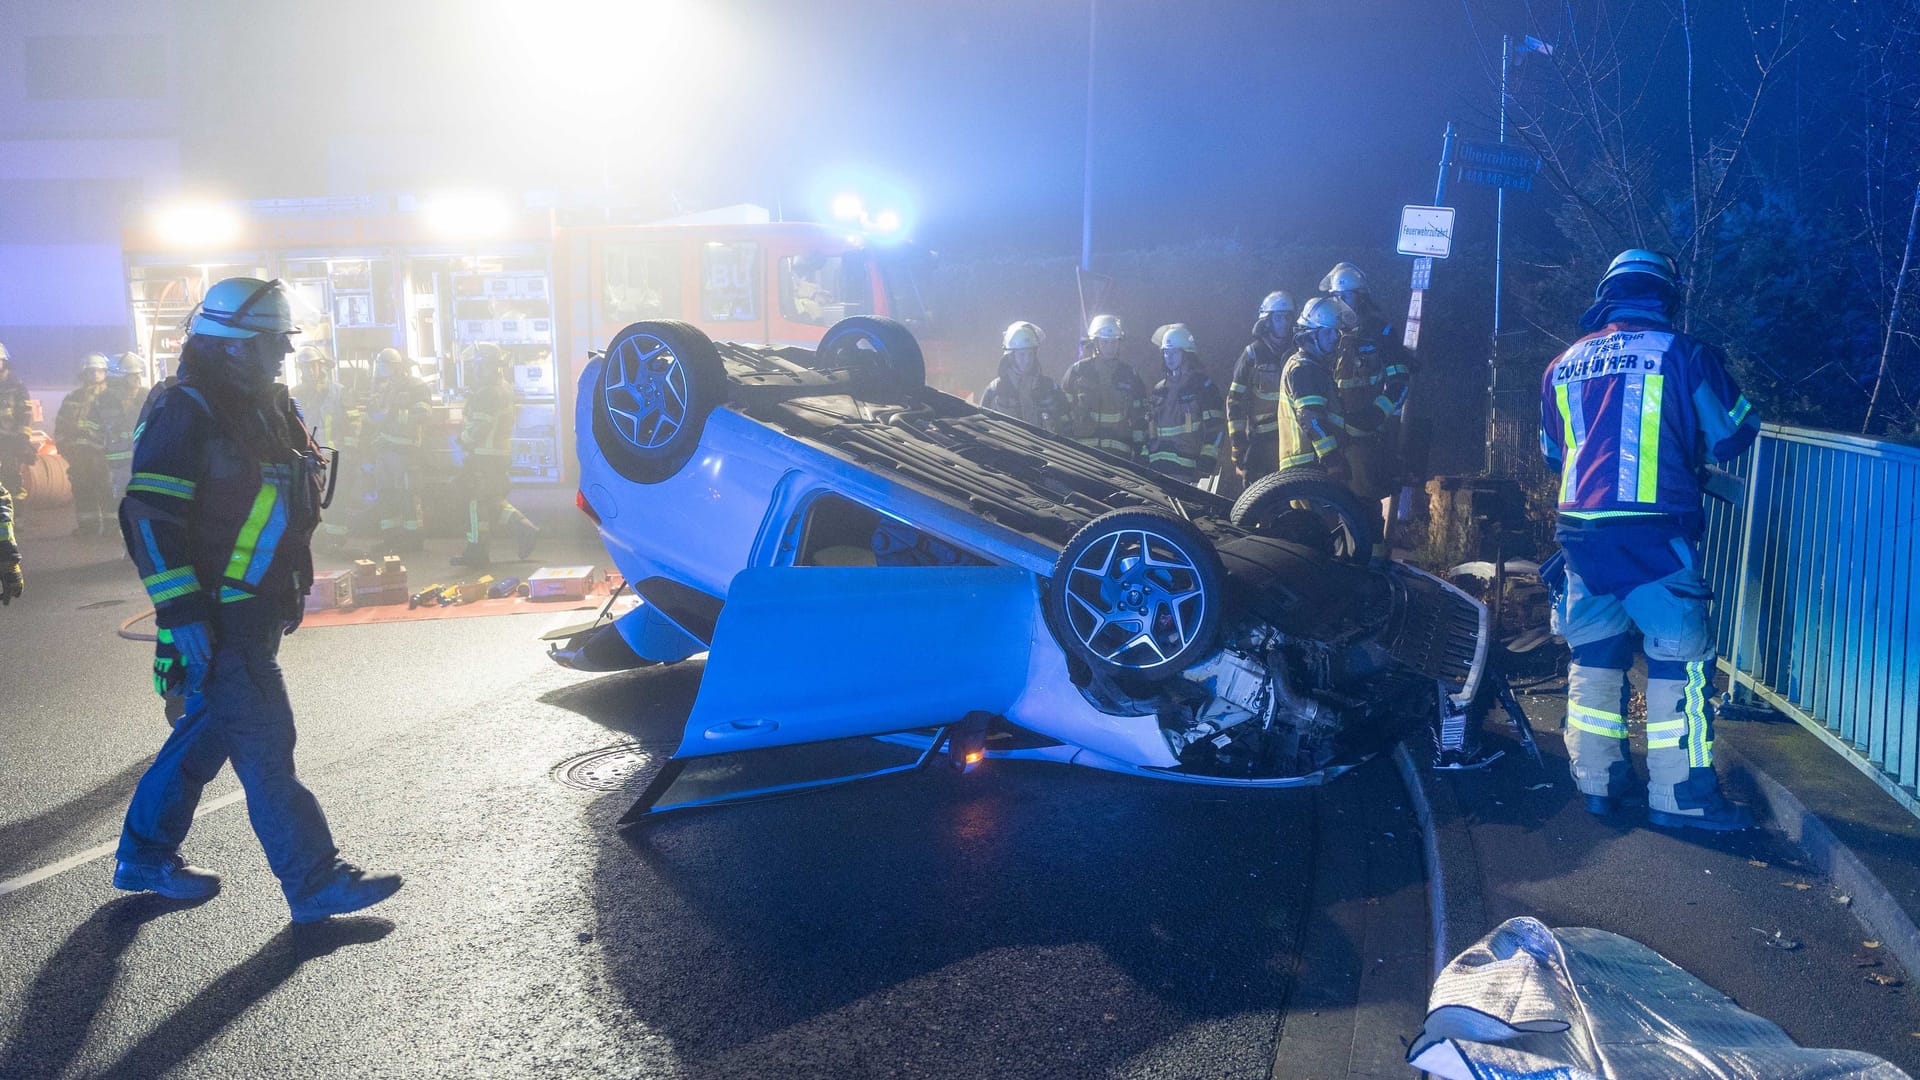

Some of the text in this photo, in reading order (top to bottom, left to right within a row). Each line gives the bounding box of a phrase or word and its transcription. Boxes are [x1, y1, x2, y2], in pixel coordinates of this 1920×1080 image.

[1584, 333, 1645, 347] FEUERWEHR
[1595, 342, 1626, 353] ESSEN
[1558, 355, 1638, 380] ZUGFÜHRER
